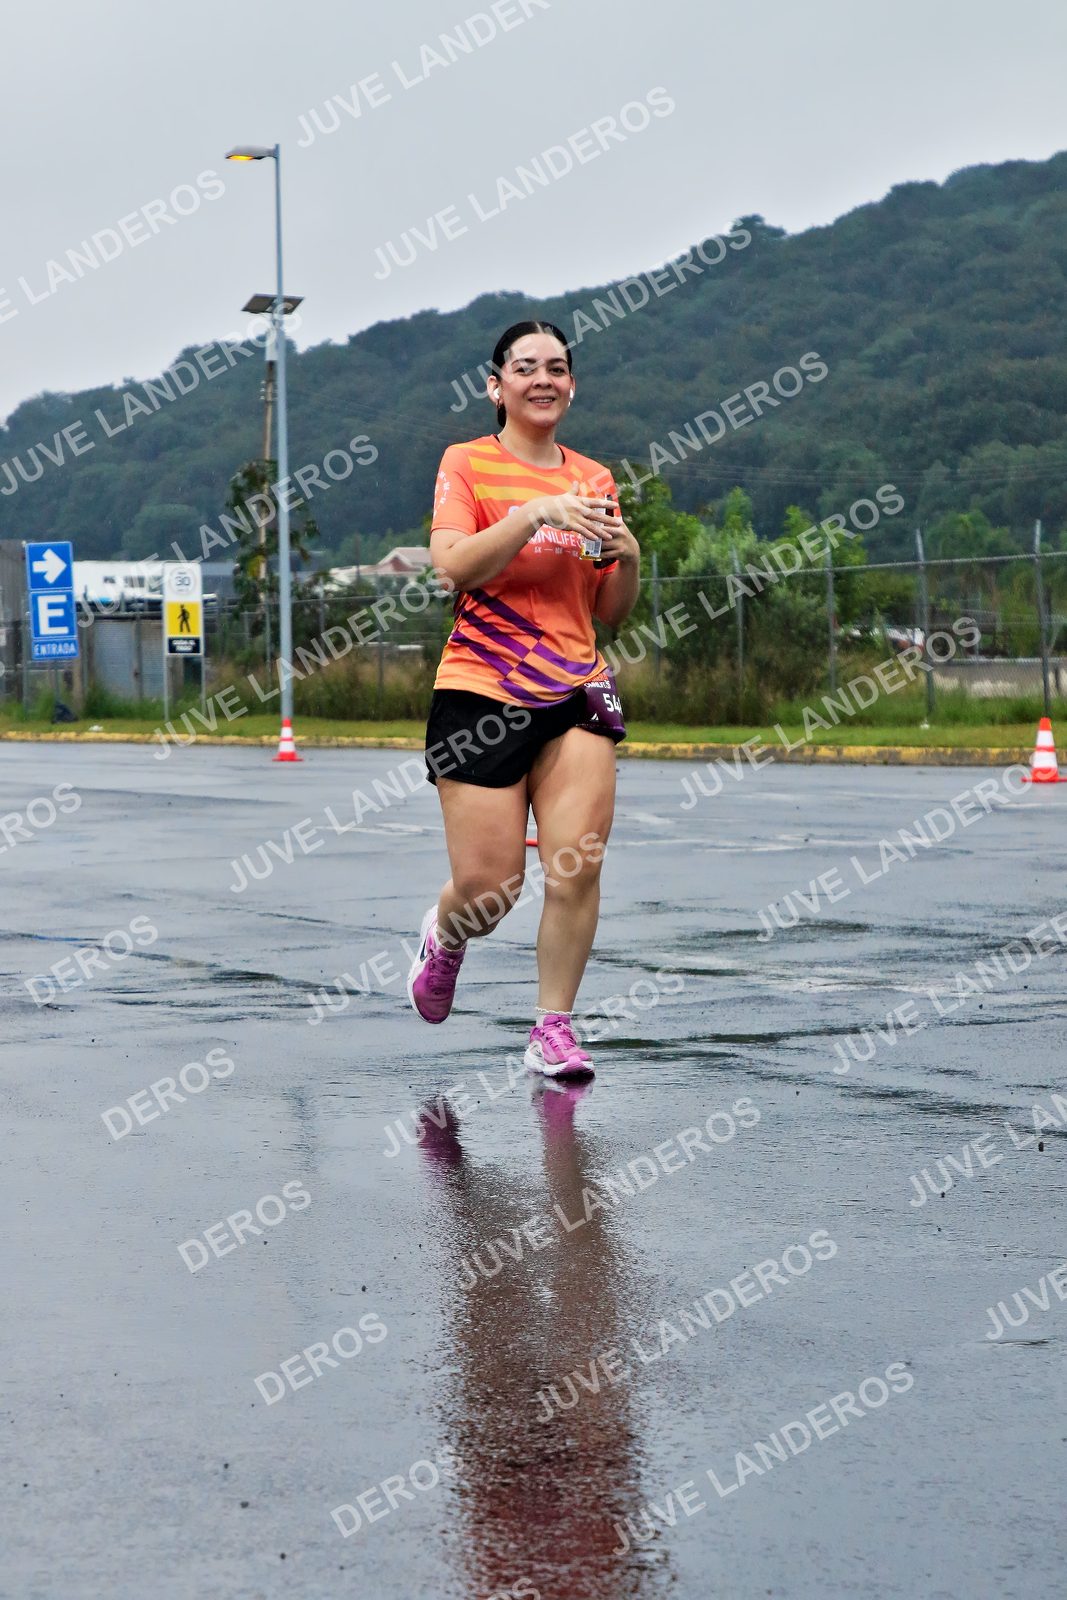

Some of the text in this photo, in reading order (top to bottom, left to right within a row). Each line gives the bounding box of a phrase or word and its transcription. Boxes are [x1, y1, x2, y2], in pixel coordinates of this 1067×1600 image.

[528, 530, 577, 547] MNILIFE
[38, 595, 69, 635] E
[34, 642, 76, 656] ENTRADA
[602, 692, 624, 715] 54
